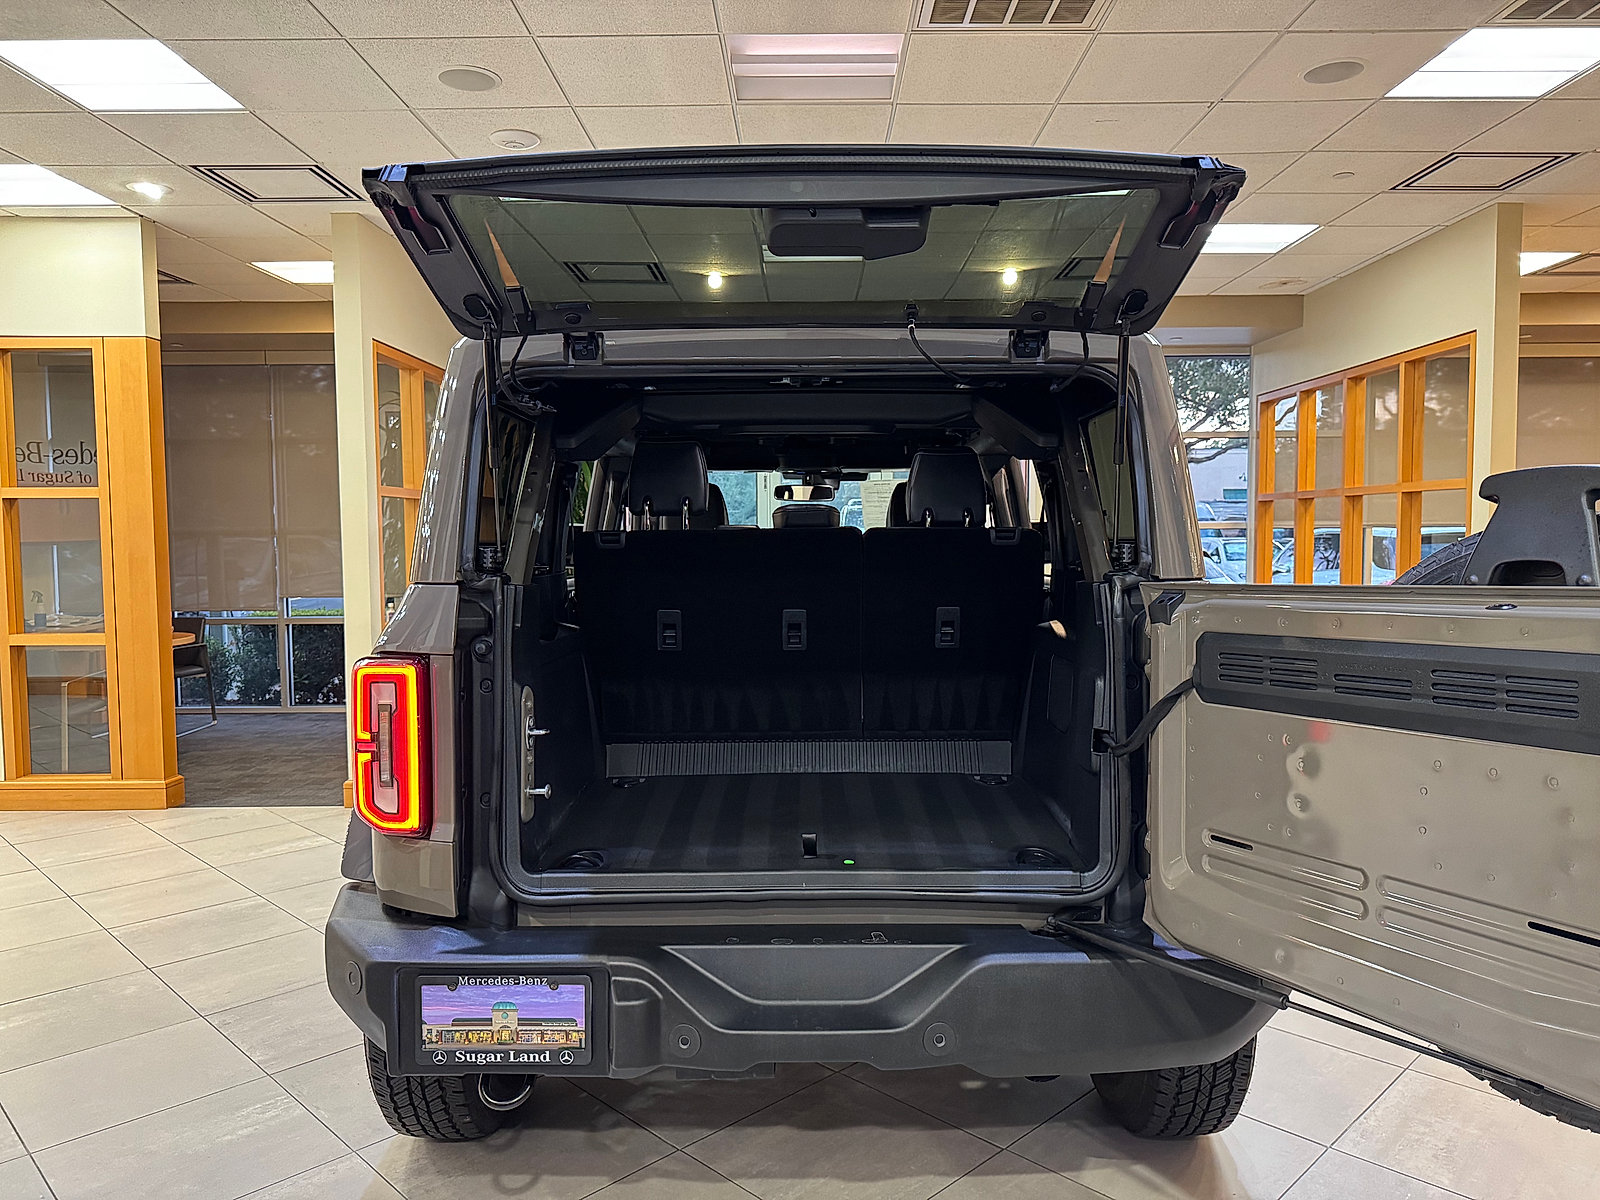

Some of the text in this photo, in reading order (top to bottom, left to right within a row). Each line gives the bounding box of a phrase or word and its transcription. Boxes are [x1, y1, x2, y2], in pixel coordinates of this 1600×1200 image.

[458, 976, 548, 986] Mercedes-Benz
[455, 1050, 551, 1065] Sugar Land
